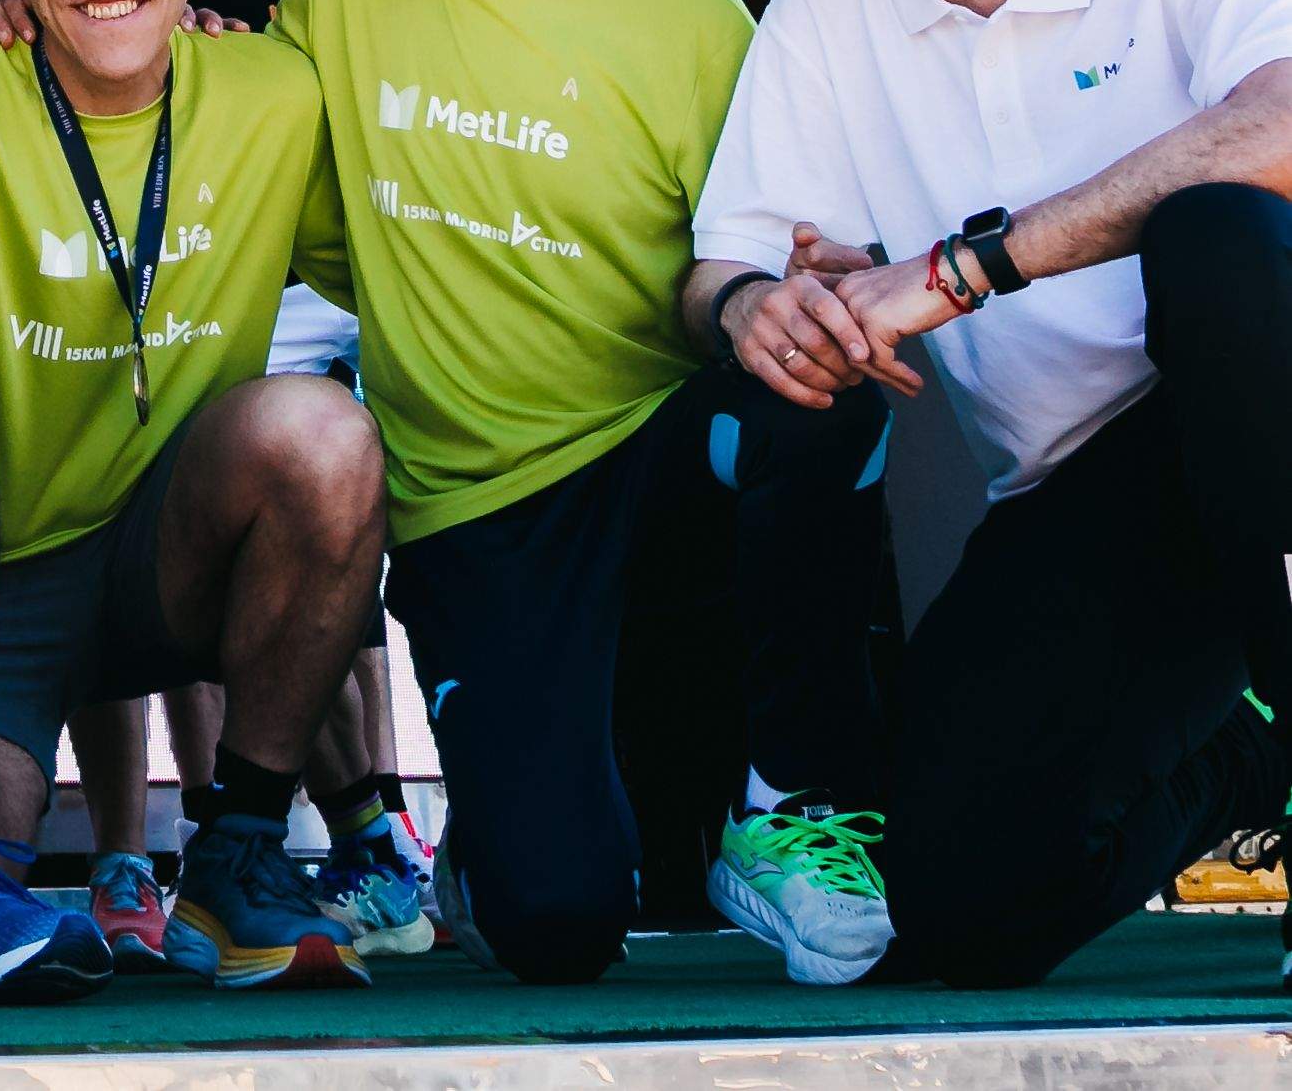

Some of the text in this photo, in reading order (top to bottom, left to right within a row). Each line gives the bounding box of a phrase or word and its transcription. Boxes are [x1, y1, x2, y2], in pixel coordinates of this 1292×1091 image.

[425, 95, 569, 160] MetLife
[92, 199, 112, 242] MetLife
[403, 204, 442, 223] 15KM
[444, 211, 509, 244] MADRID
[510, 210, 583, 259] ACTIVA
[140, 263, 153, 308] MetLife
[9, 313, 64, 361] VIII
[65, 345, 108, 362] 15KM
